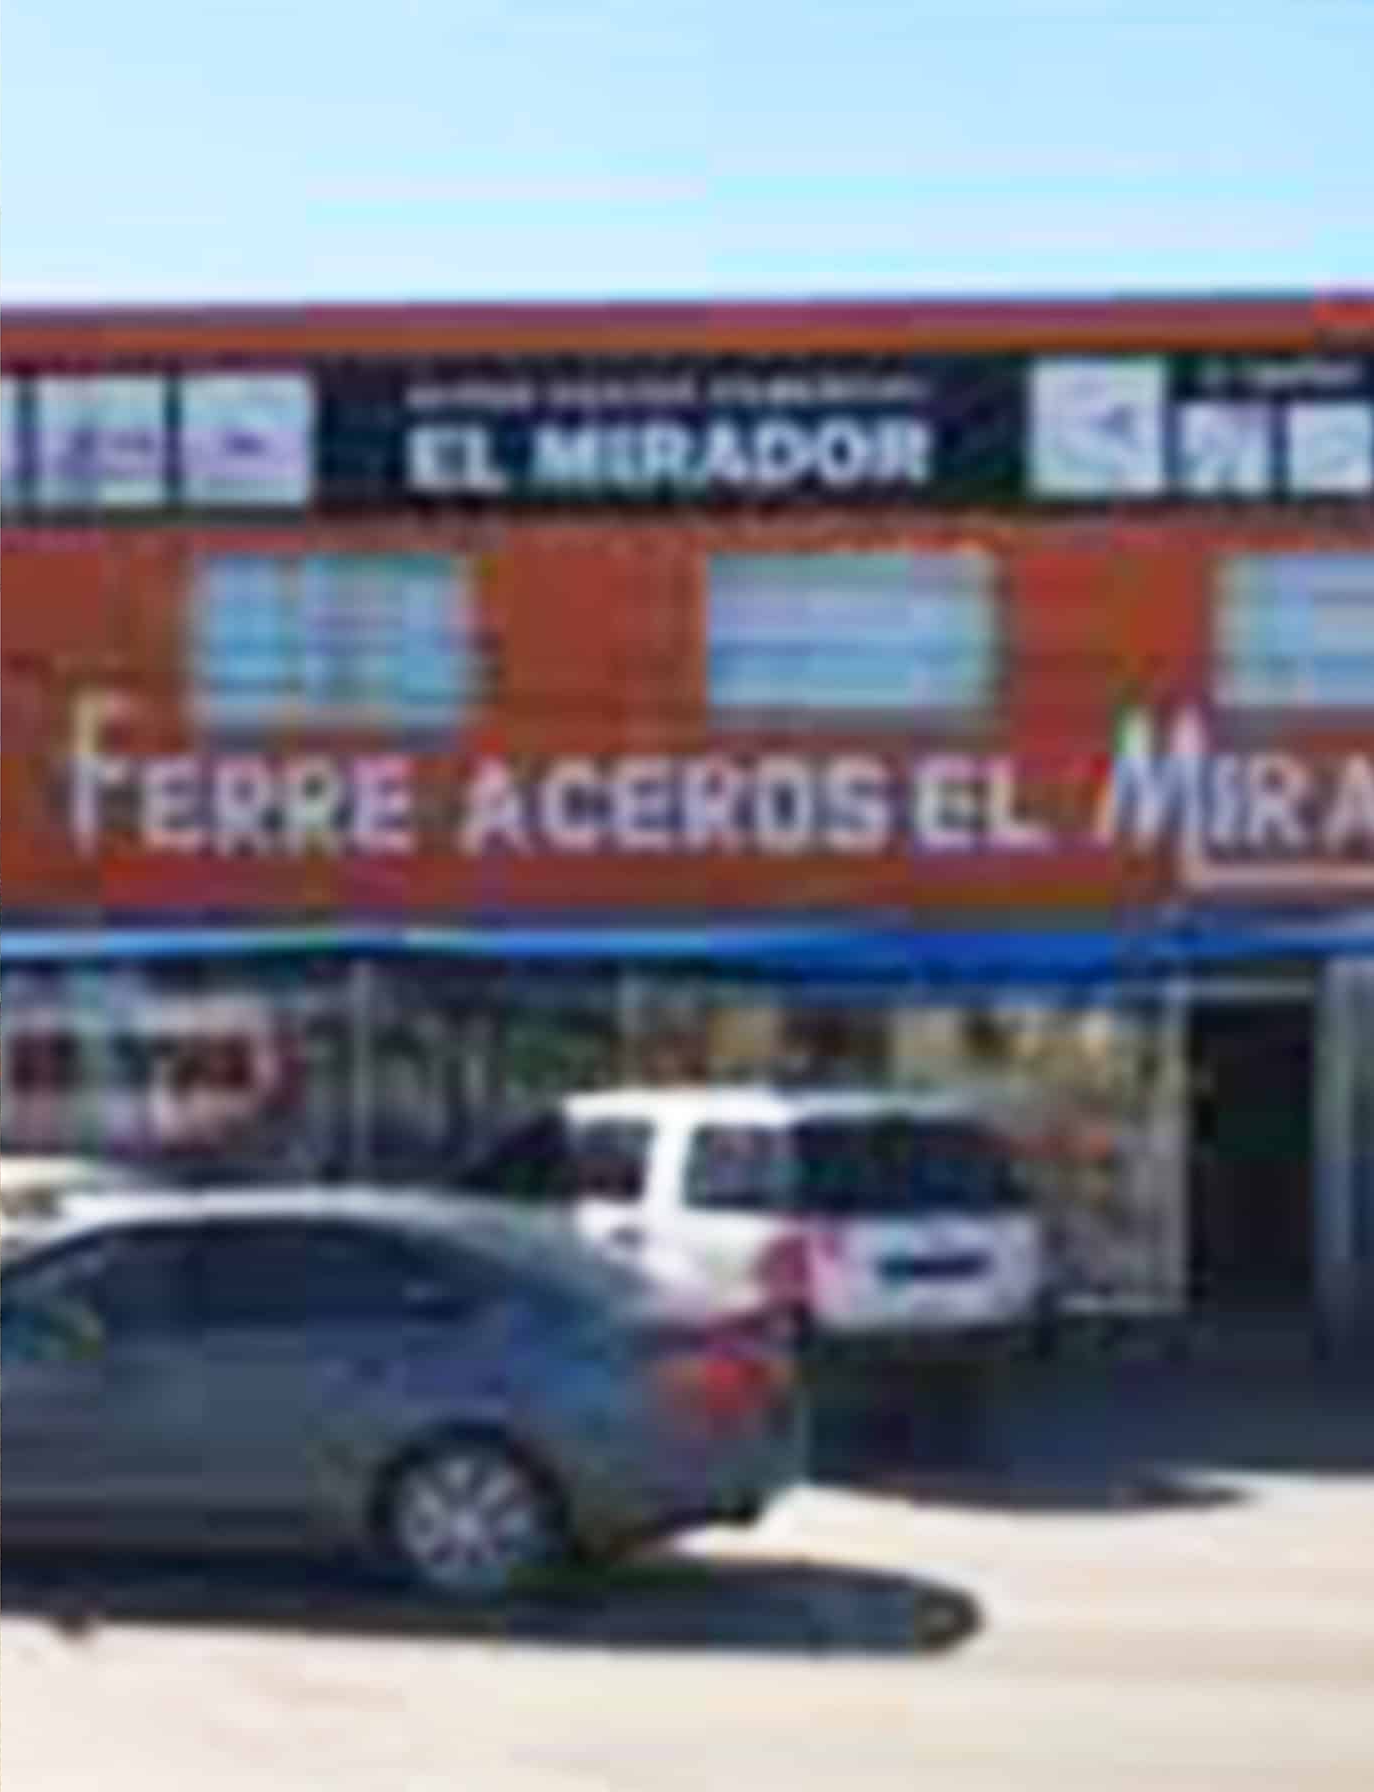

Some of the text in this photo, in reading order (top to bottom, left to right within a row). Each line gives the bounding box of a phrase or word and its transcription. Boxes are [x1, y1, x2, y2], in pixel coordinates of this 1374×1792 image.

[408, 417, 931, 491] EL MIRADOR
[69, 688, 416, 858] FERRE
[461, 754, 889, 854] ACEROS
[916, 752, 1054, 853] EL
